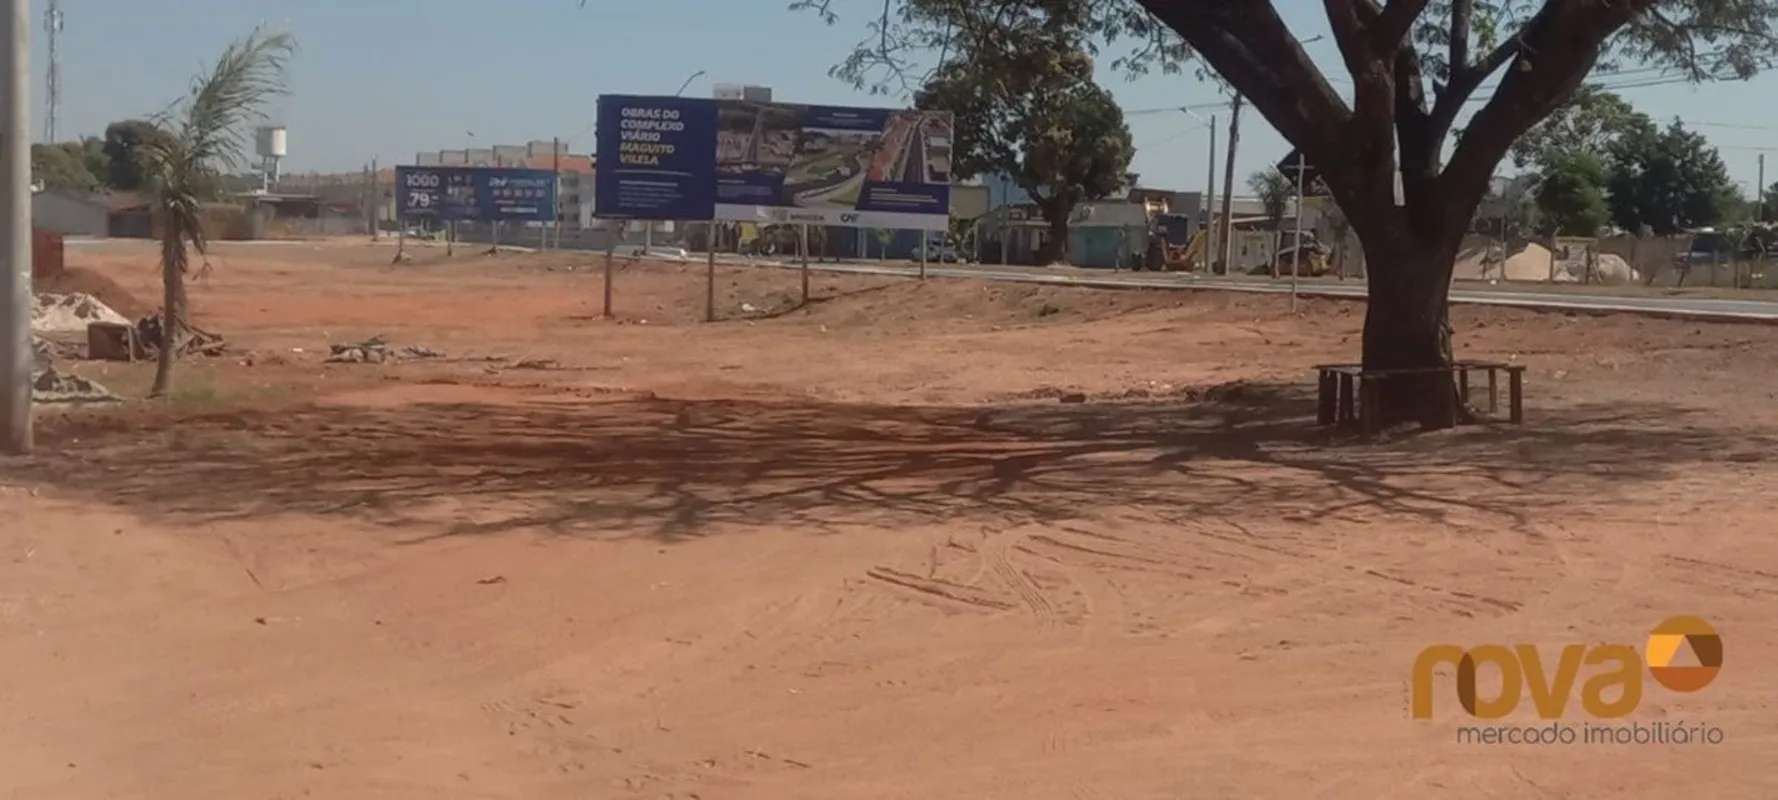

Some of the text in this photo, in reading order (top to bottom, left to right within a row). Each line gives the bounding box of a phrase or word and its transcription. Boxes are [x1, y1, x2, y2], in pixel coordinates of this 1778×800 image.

[621, 107, 680, 119] OBRAS DO
[620, 119, 684, 131] COMPLEXO
[620, 129, 661, 142] VIÁRIO
[620, 142, 675, 154] MAGUITO
[620, 153, 659, 166] VILELA
